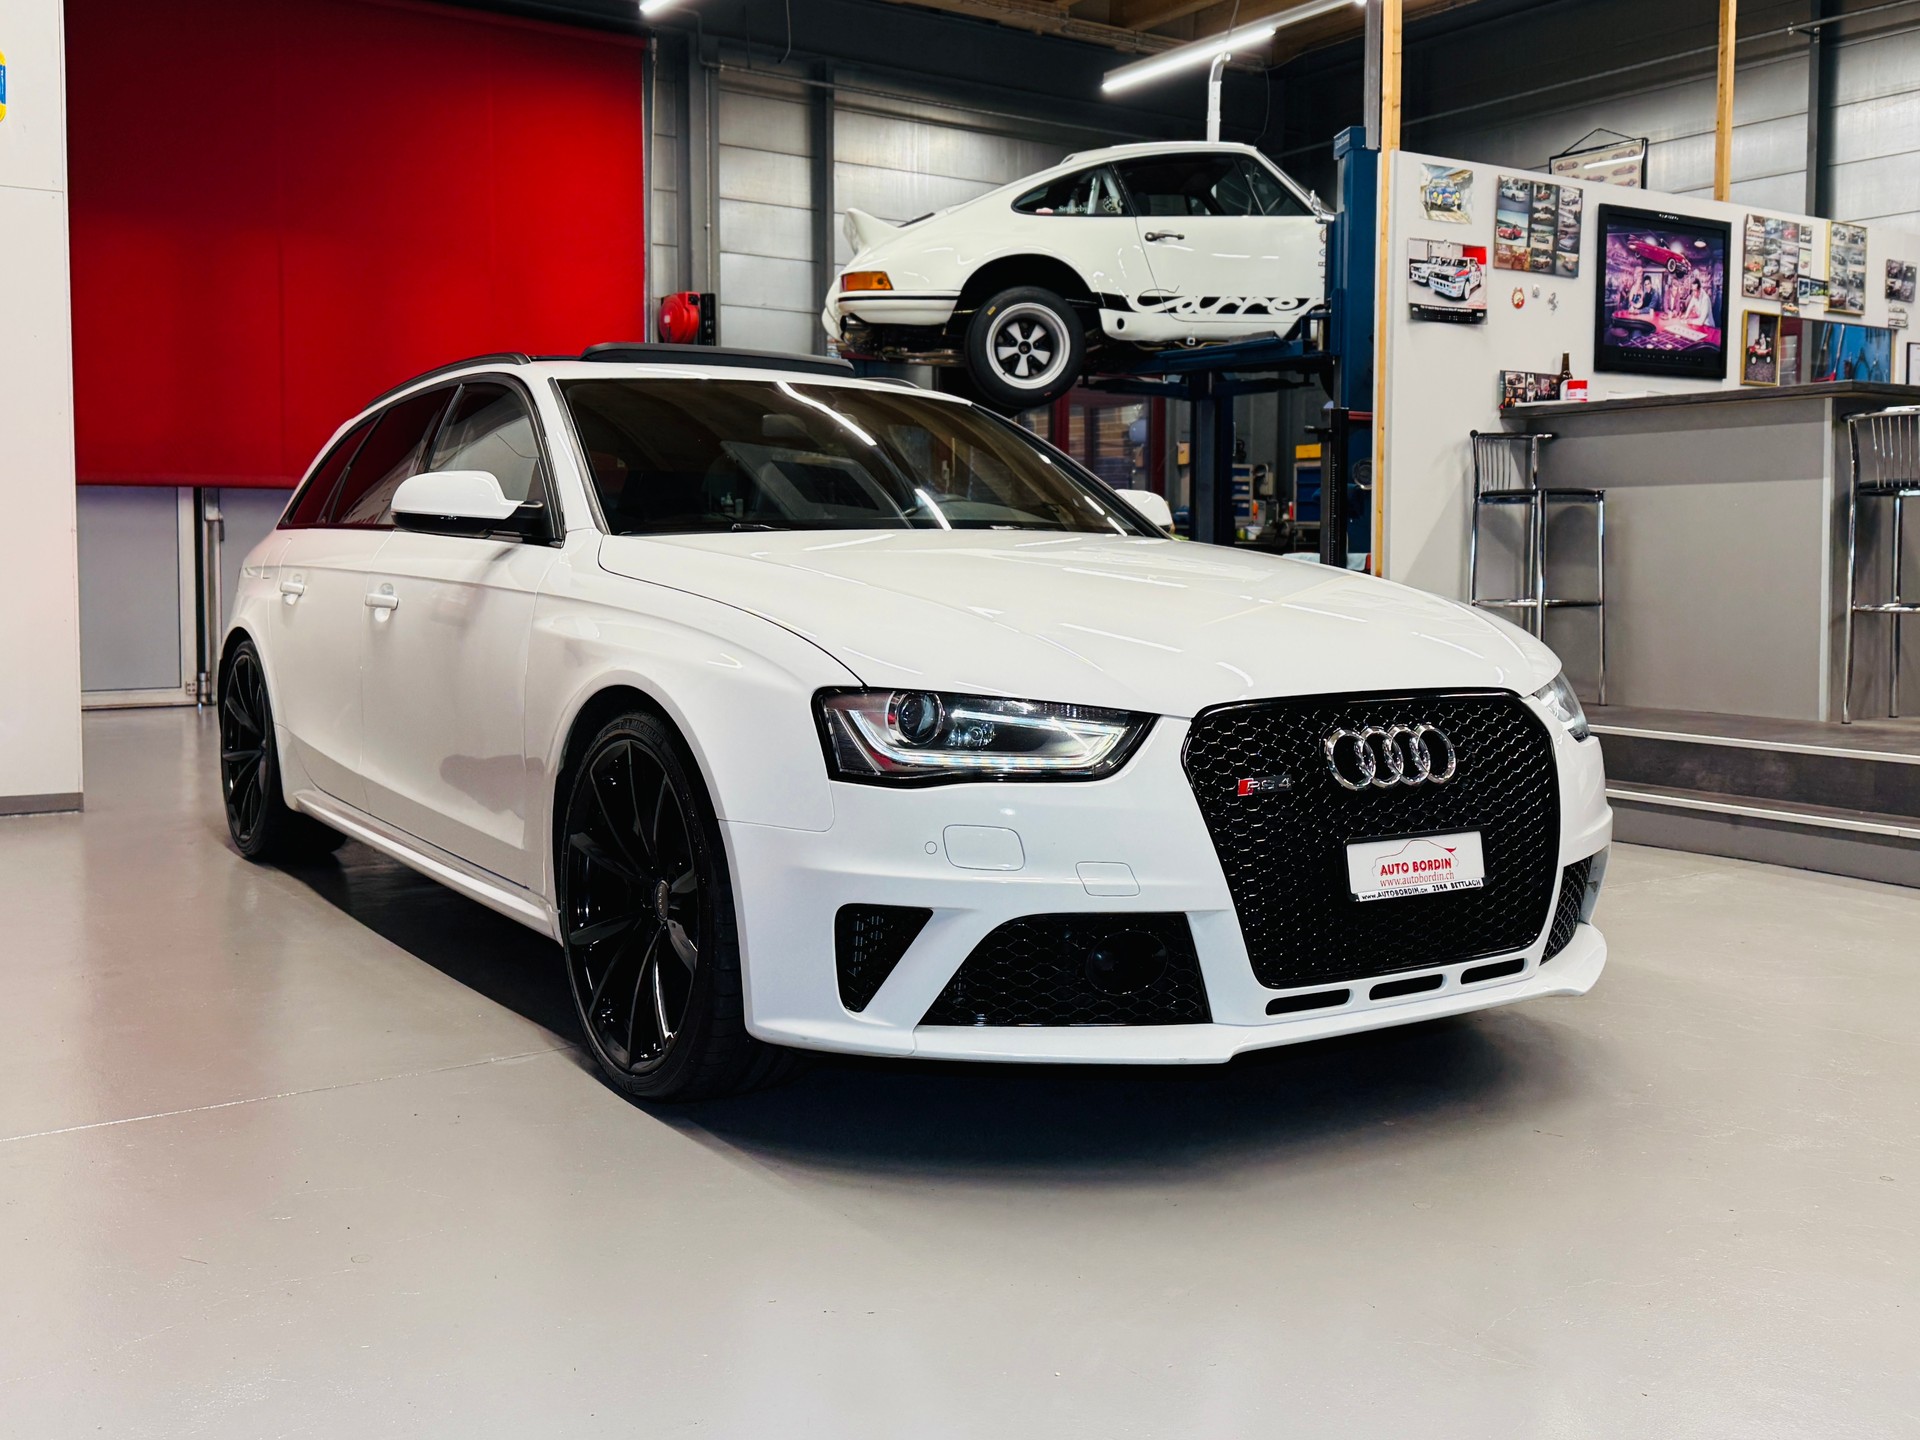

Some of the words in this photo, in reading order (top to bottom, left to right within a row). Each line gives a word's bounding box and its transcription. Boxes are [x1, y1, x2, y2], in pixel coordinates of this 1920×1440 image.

[1124, 285, 1325, 316] Carrer
[1380, 862, 1409, 876] AUTO
[1412, 858, 1452, 873] BORDIN
[1380, 870, 1455, 887] www.autobordin.ch
[1450, 879, 1482, 890] BETTLACH
